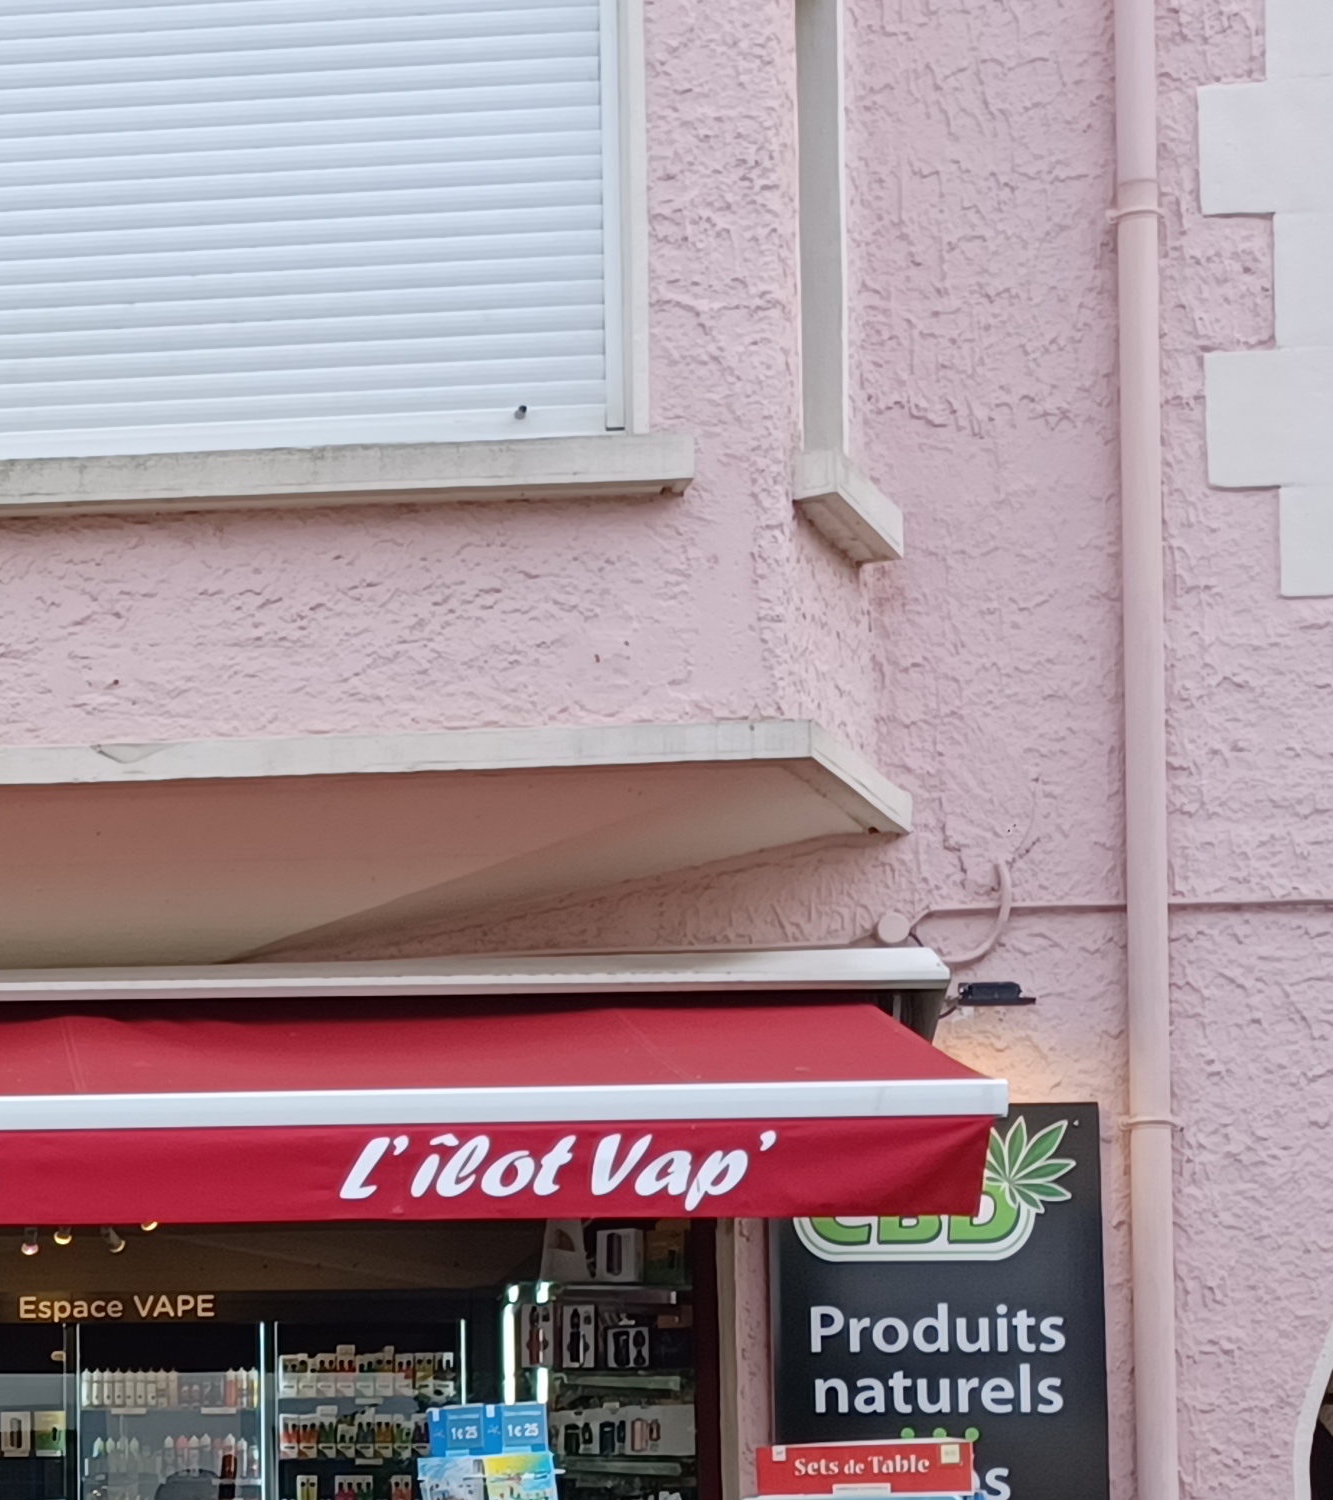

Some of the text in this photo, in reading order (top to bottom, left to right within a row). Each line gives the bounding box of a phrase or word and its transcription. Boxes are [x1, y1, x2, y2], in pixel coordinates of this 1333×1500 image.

[340, 1130, 777, 1211] L'îlot Vap'
[19, 1295, 215, 1323] Espace VAPE
[810, 1302, 1066, 1353] Produits
[814, 1363, 1064, 1414] naturels
[794, 1454, 930, 1476] Sets de Table
